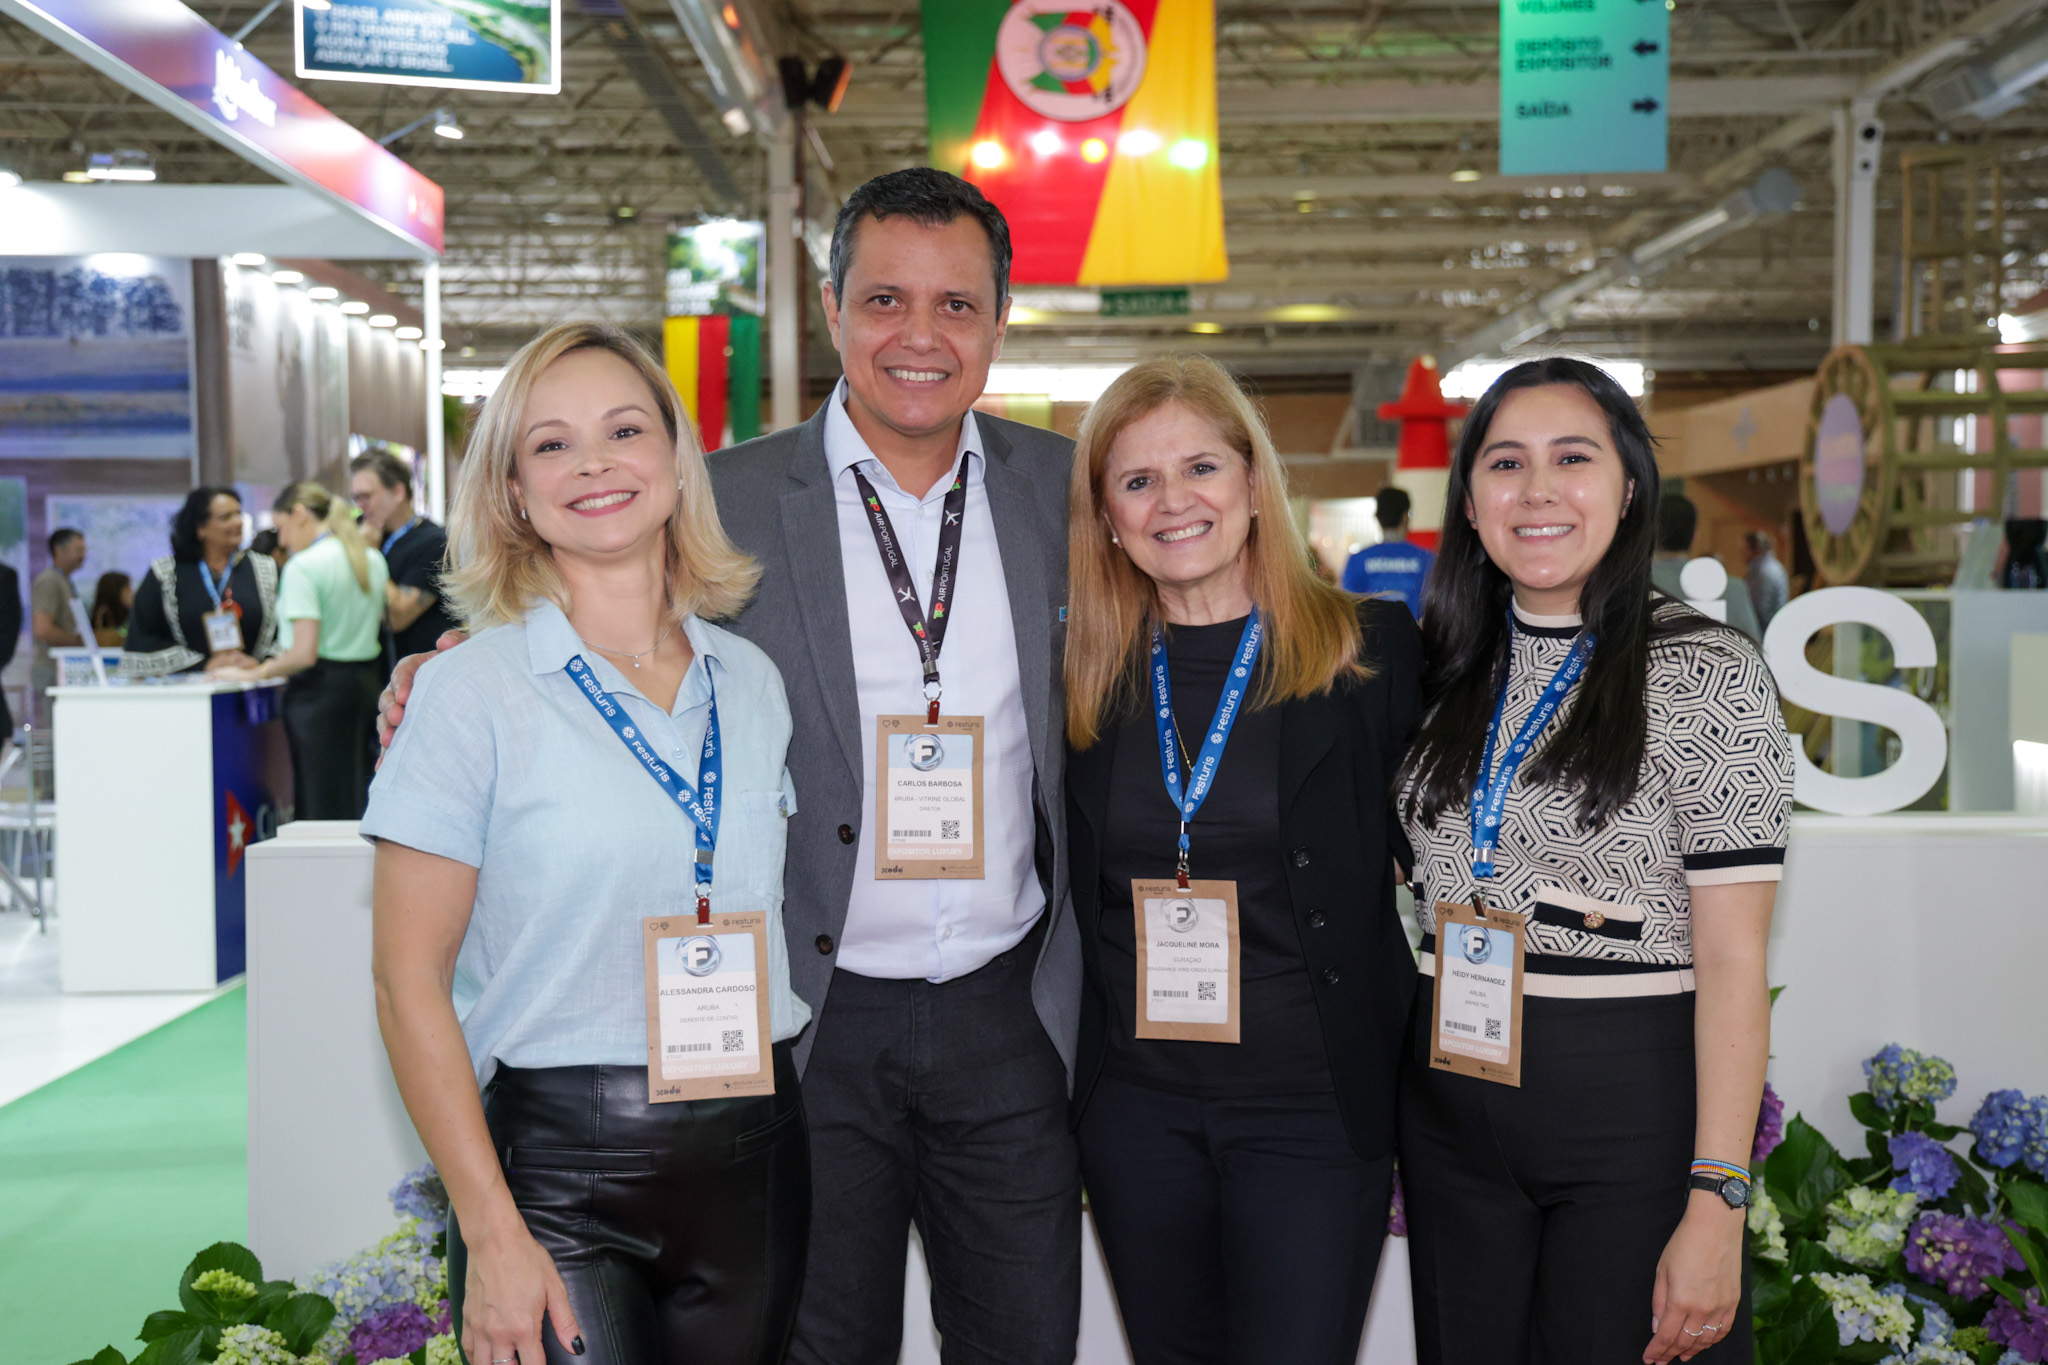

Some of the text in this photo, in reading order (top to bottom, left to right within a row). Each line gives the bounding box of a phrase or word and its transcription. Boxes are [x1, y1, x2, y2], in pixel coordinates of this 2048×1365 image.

[1515, 35, 1602, 53] DEPÓSITO
[1515, 54, 1613, 71] EXPOSITOR
[1516, 99, 1571, 119] SAÍDA
[1240, 623, 1262, 665] Festuris
[580, 672, 617, 718] Festuris
[1156, 665, 1169, 706] Festuris
[1217, 689, 1239, 731] Festuris
[1524, 701, 1554, 741] Festuris
[632, 740, 670, 783] Festuris
[1164, 729, 1175, 770] Festuris
[1192, 755, 1215, 800] Festuris
[1491, 765, 1513, 812] Festuris
[731, 917, 761, 926] Festuris
[1156, 941, 1198, 949] JACQUELINE
[659, 984, 756, 996] ALESSANDRA CARDOSO
[1452, 970, 1506, 987] HEIDY HERNANDEZ
[1469, 989, 1487, 998] ARUBA
[679, 1016, 706, 1024] GERENTE
[716, 1014, 738, 1022] CONTAS
